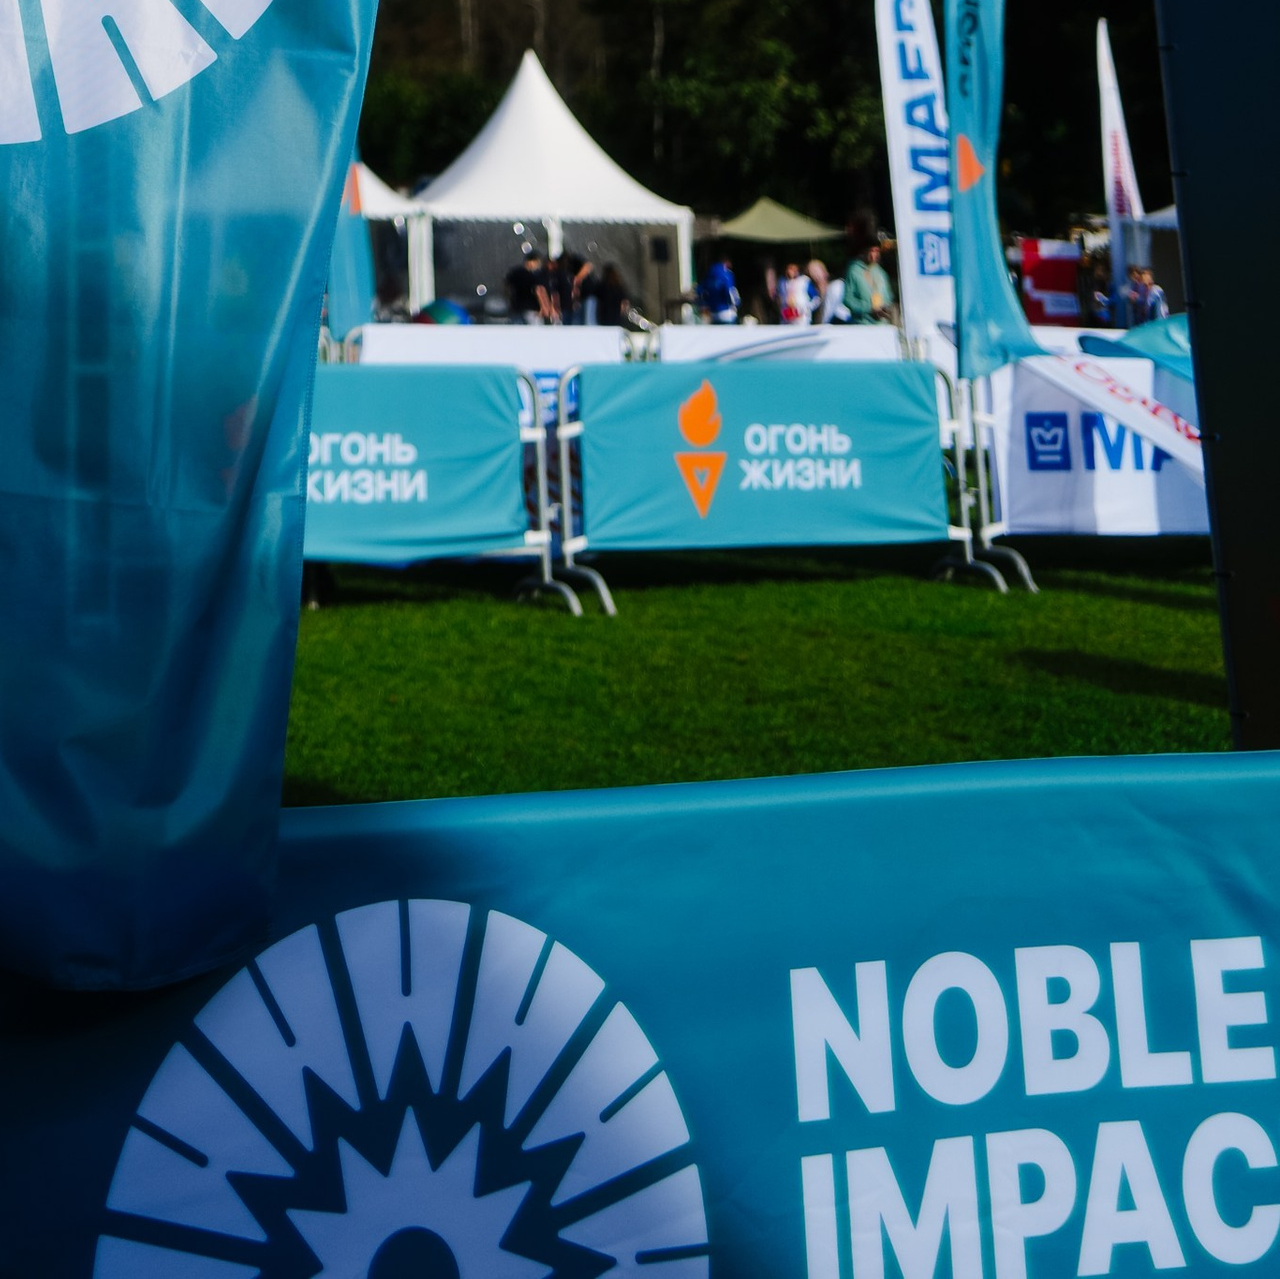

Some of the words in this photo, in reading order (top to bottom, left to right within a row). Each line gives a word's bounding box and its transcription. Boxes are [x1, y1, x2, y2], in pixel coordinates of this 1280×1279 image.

[738, 457, 862, 490] ЖИЗНИ
[744, 423, 853, 455] ОГОНЬ
[790, 936, 1277, 1122] NOBLE
[801, 1112, 1280, 1279] IMPAC
